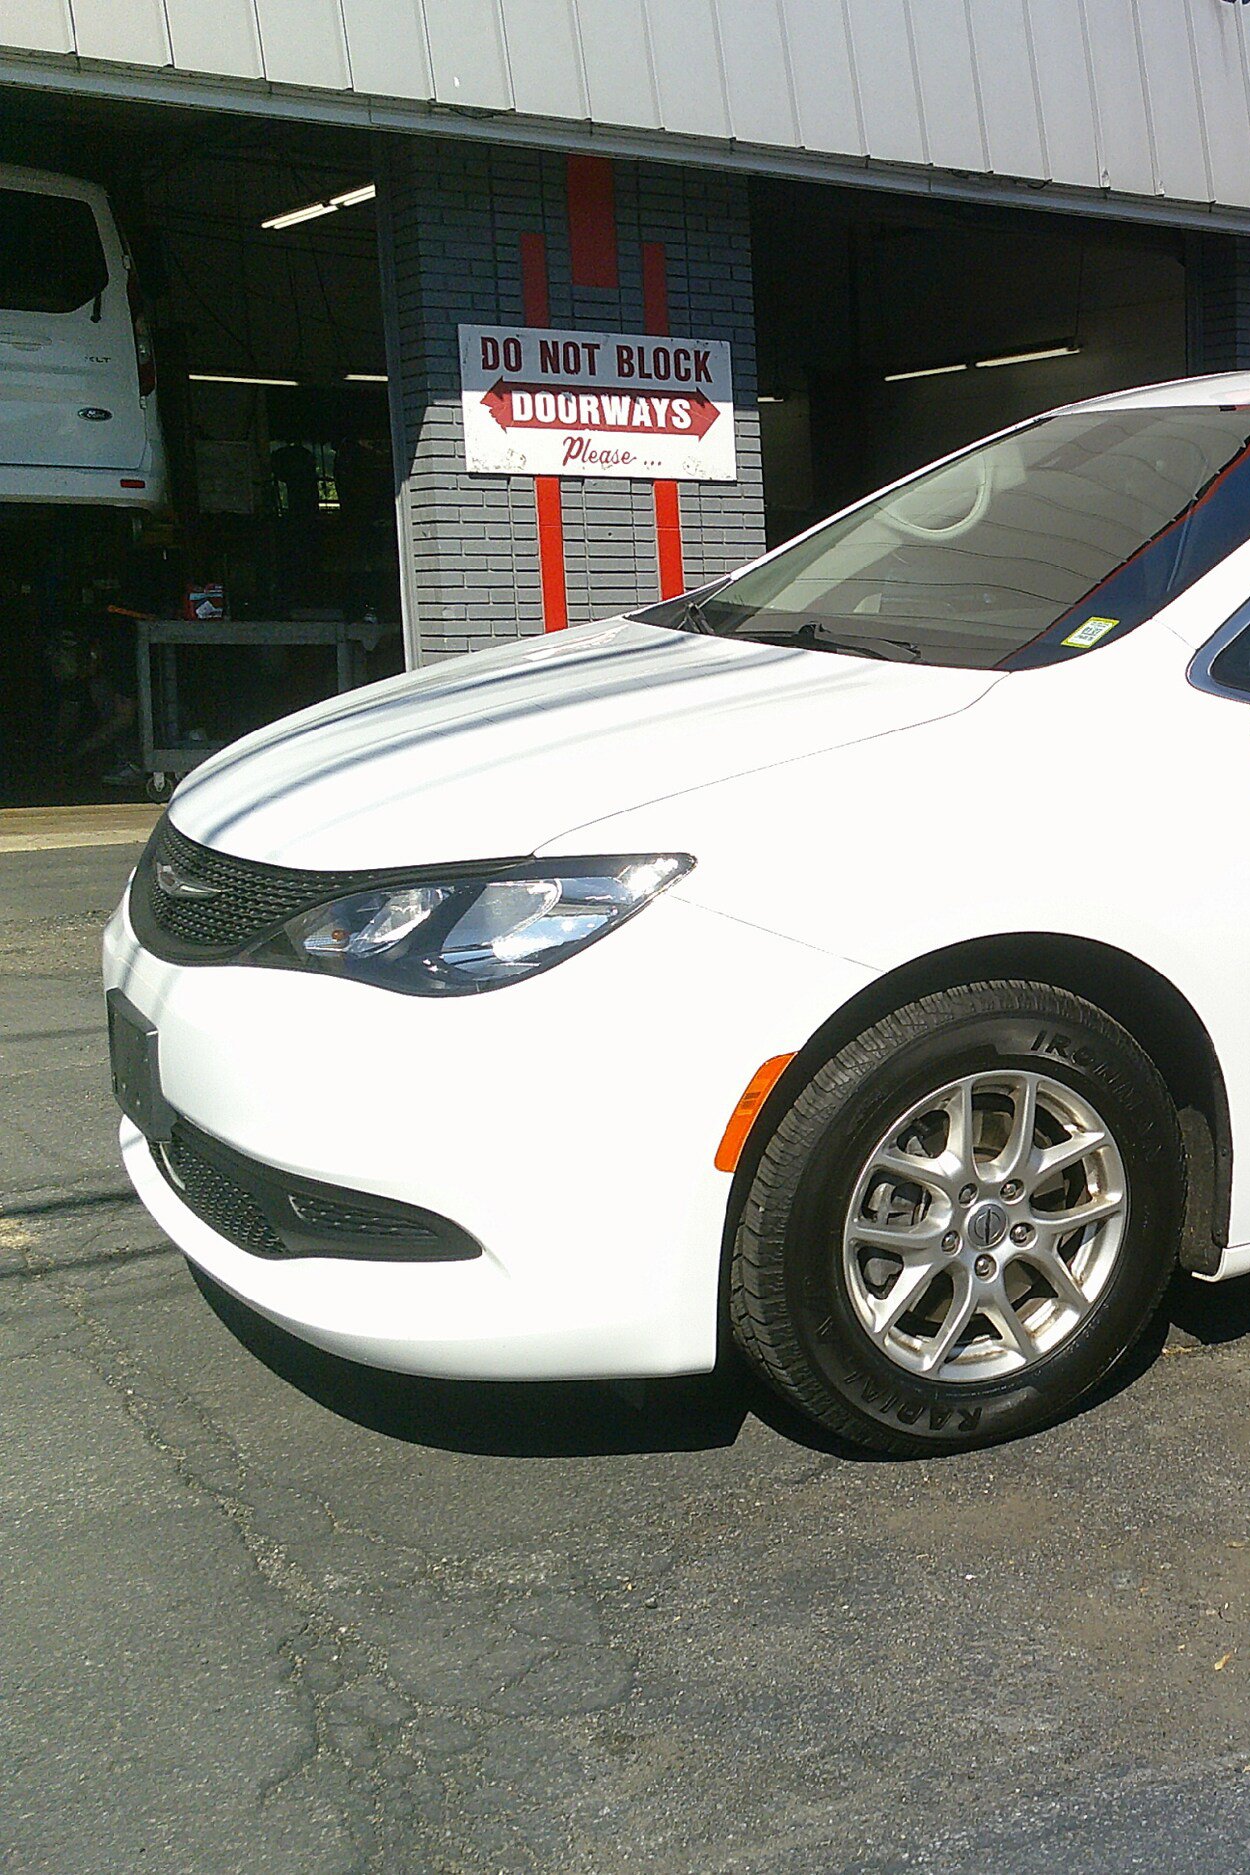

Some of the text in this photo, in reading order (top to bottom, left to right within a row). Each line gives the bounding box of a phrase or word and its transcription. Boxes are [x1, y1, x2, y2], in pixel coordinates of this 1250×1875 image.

[480, 336, 714, 384] DO NOT BLOCK
[511, 390, 693, 430] DOORWAYS
